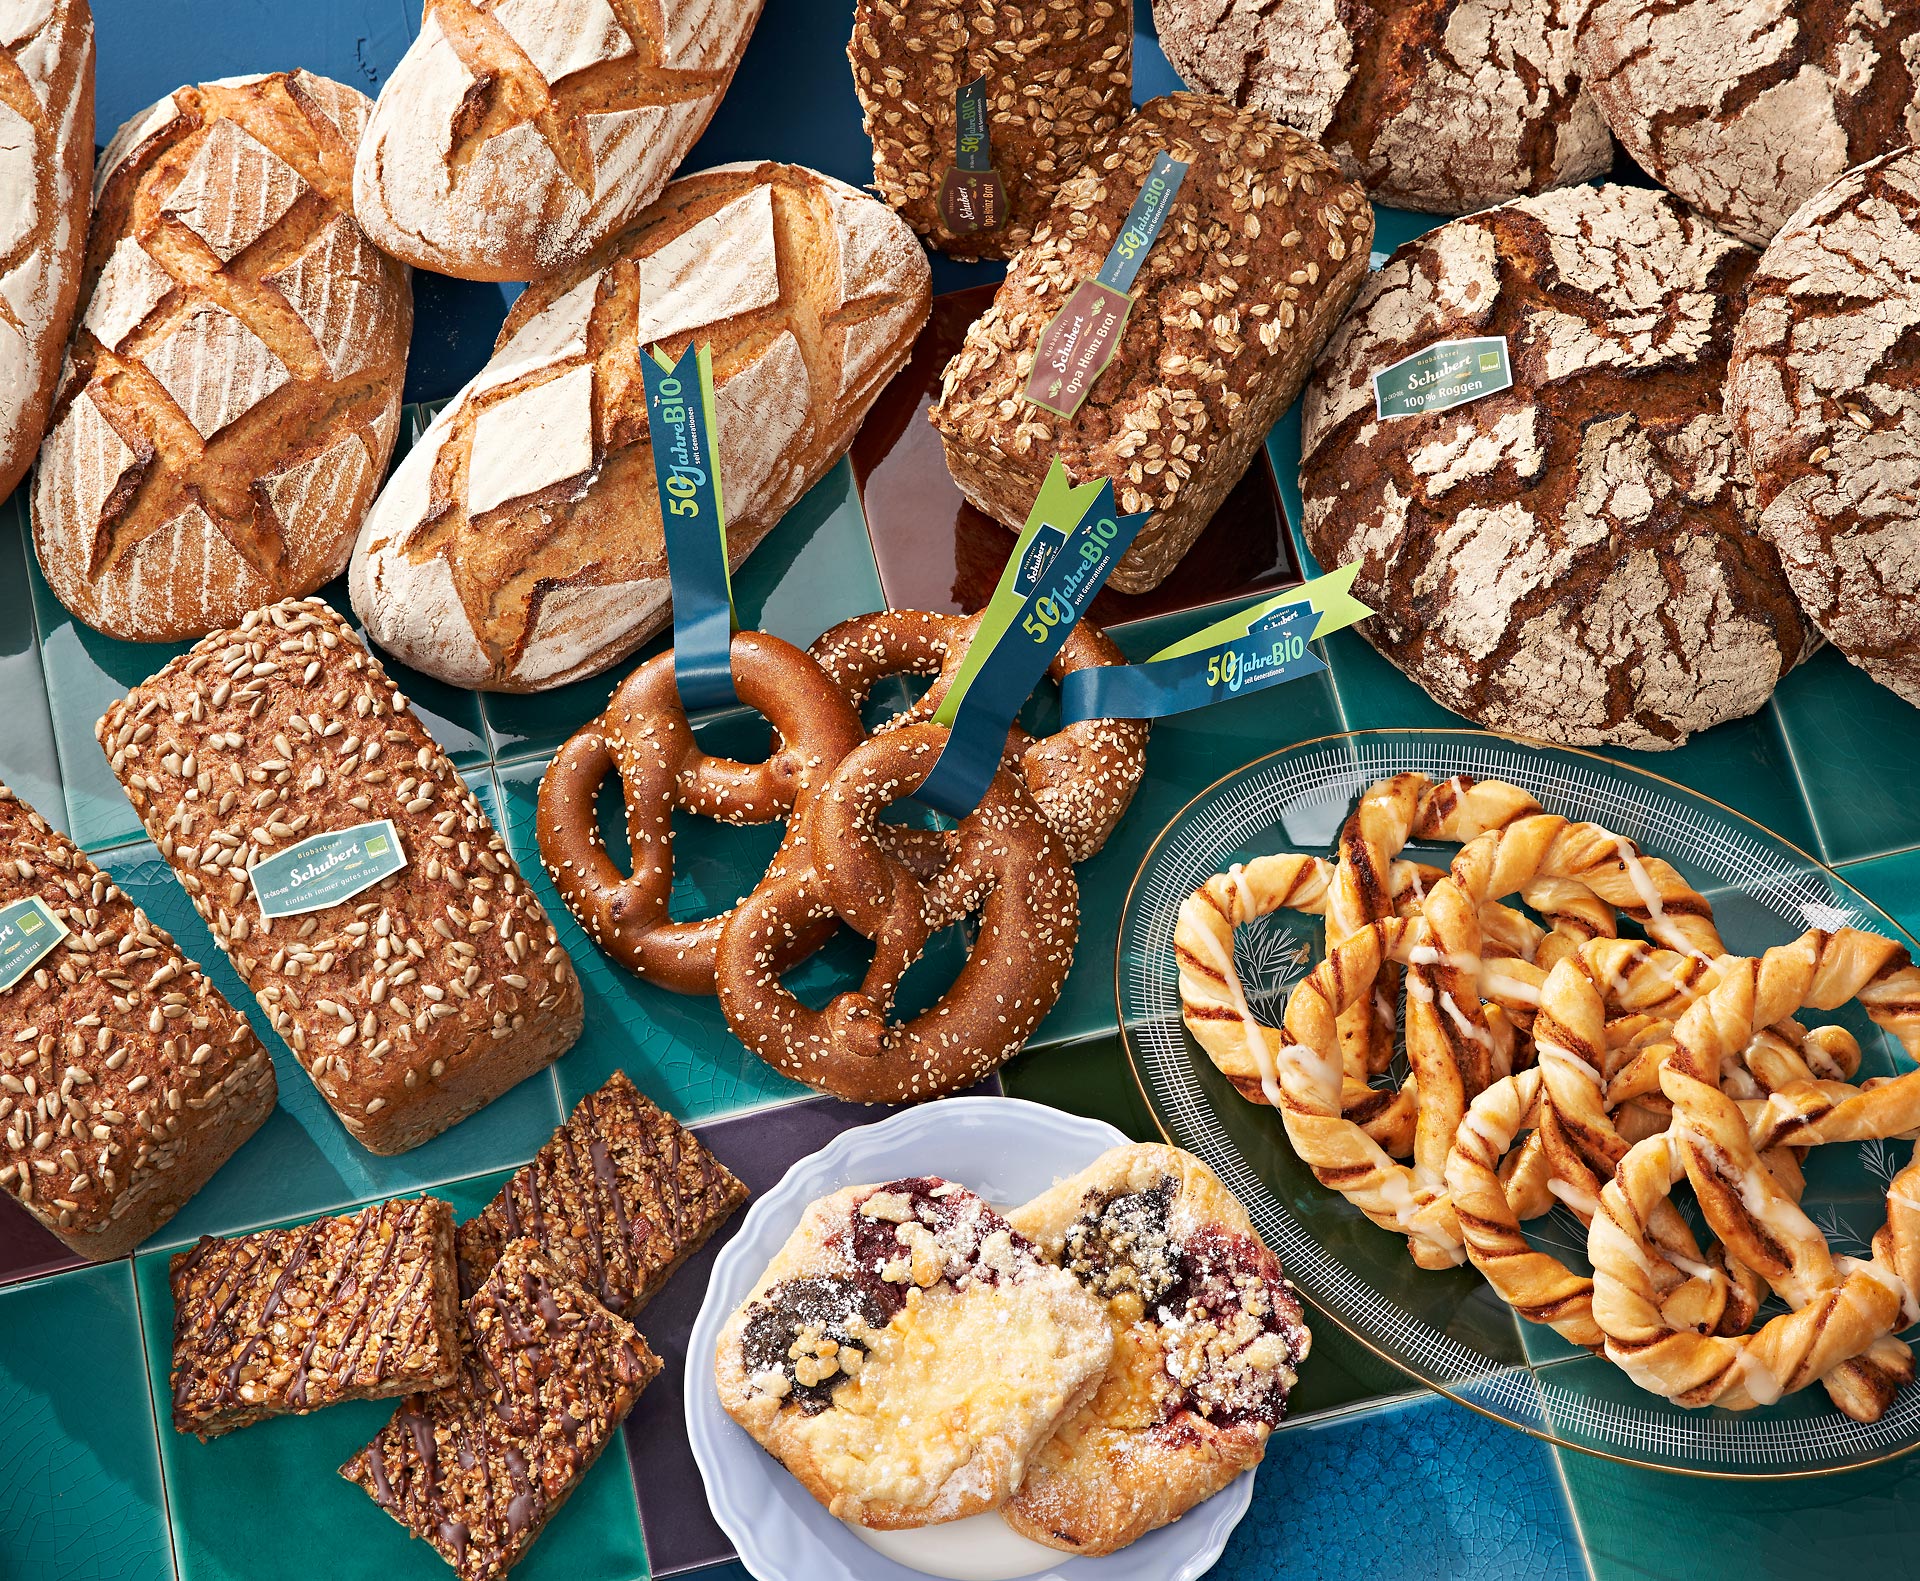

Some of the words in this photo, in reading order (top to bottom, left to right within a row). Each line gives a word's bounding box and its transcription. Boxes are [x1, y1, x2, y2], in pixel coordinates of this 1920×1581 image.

[957, 187, 975, 220] Schubert
[983, 184, 993, 198] Brot
[983, 198, 993, 214] Heinz
[1152, 188, 1171, 226] Generationen
[984, 214, 996, 227] Opa
[1147, 222, 1158, 235] seit
[1052, 314, 1084, 373] Schubert
[1067, 369, 1083, 394] Opa
[1078, 336, 1102, 369] Heinz
[1098, 313, 1116, 339] Brot
[1408, 355, 1472, 390] Schubert
[1404, 396, 1424, 408] 100
[1426, 393, 1436, 401] %
[1439, 380, 1482, 398] Roggen
[688, 407, 699, 450] Generationen
[1026, 541, 1047, 583] Schubert
[1074, 592, 1085, 606] seit
[1082, 555, 1110, 594] Generationen
[1244, 676, 1253, 685] seit
[1253, 667, 1285, 682] Generationen
[291, 843, 360, 887] Schubert
[285, 893, 313, 906] Einfach
[315, 882, 338, 895] immer
[341, 873, 361, 886] gutes
[363, 866, 379, 876] Brot
[6, 955, 25, 970] gutes
[25, 942, 40, 955] Brot
